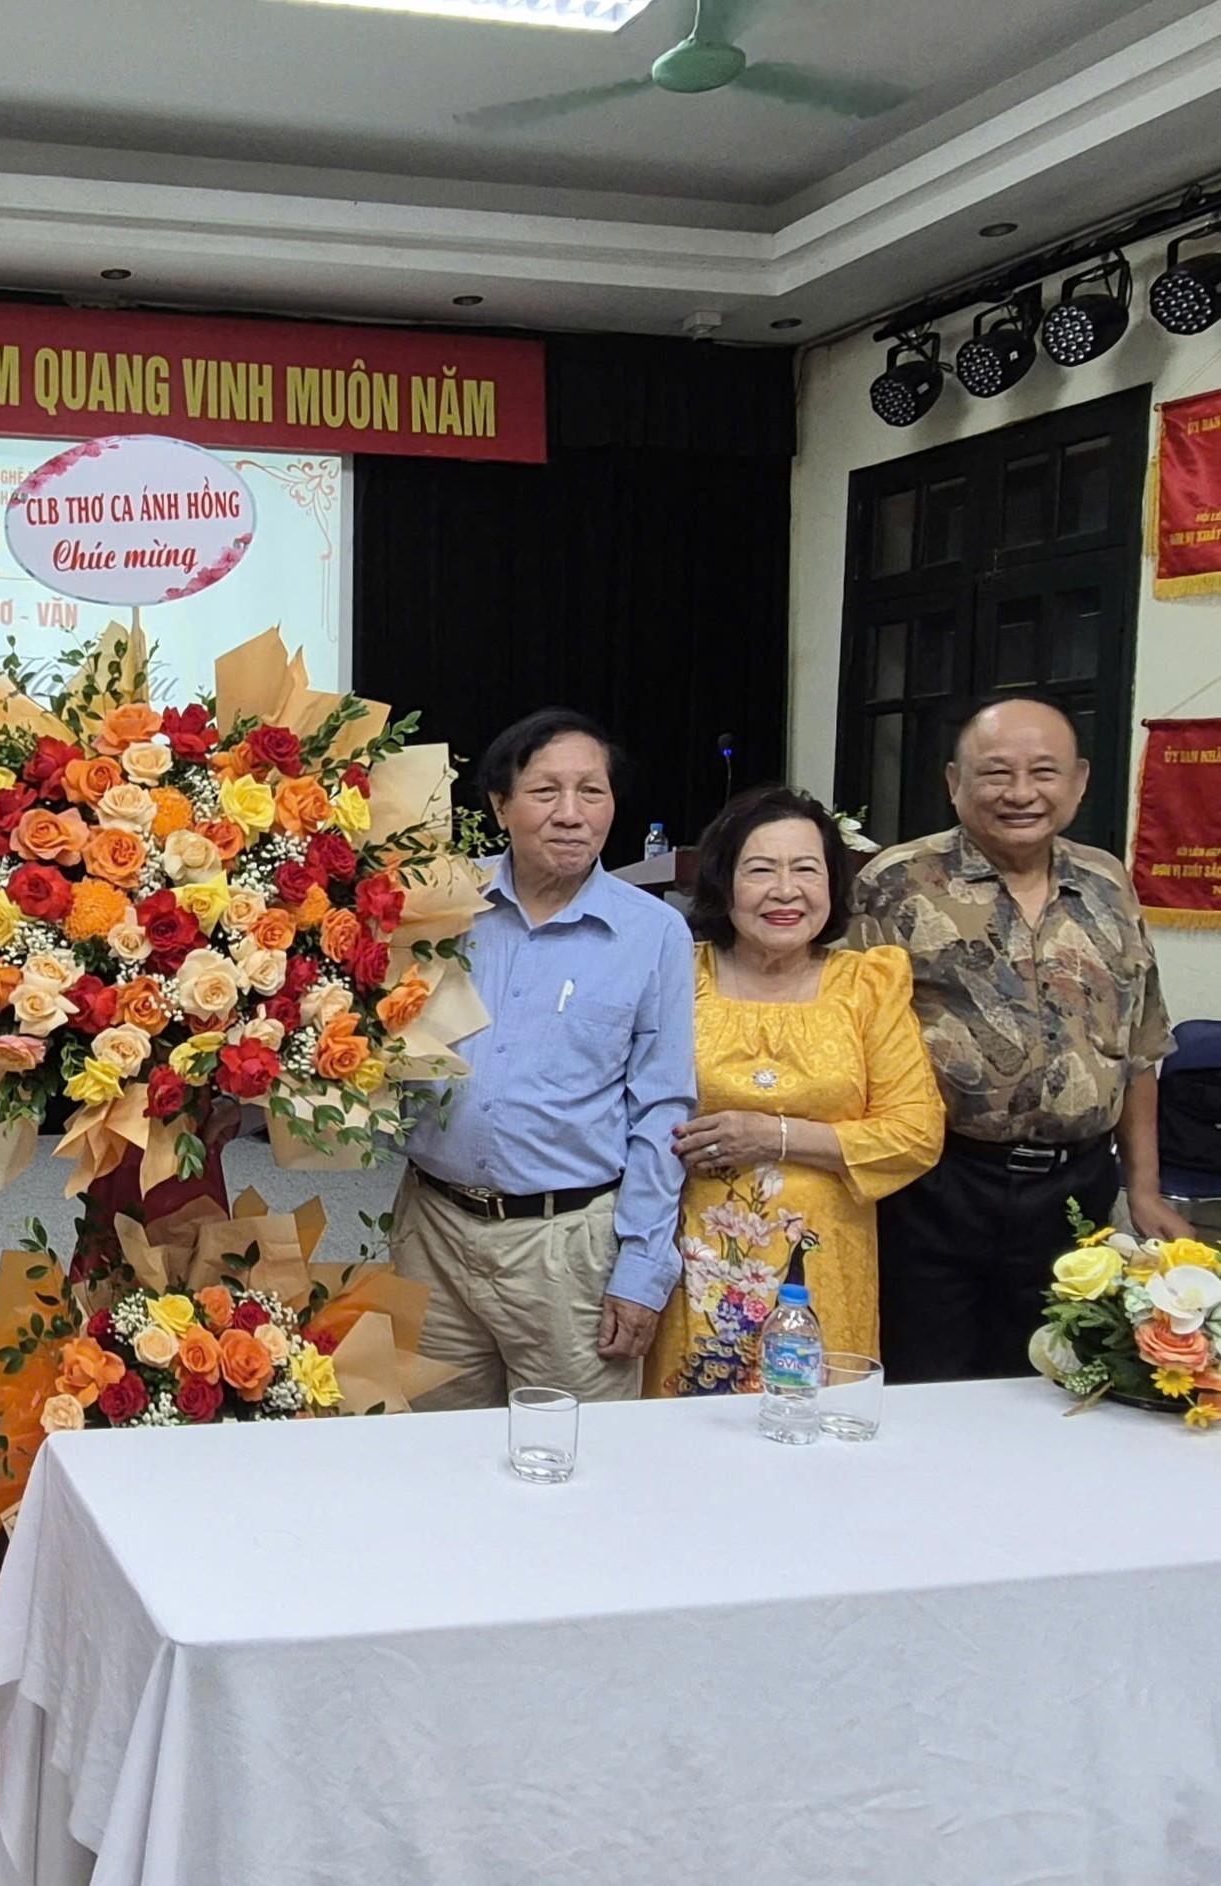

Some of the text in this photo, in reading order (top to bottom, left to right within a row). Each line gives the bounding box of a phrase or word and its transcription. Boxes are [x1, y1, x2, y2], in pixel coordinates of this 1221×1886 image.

[34, 346, 170, 416] QUANG
[181, 358, 273, 423] VINH
[286, 358, 398, 432] MUÔN
[410, 364, 496, 438] NĂM
[26, 476, 240, 526] CLB THƠ CA ÁNH HỒNG
[52, 539, 198, 574] Chúc mừng
[37, 597, 78, 628] VĂN
